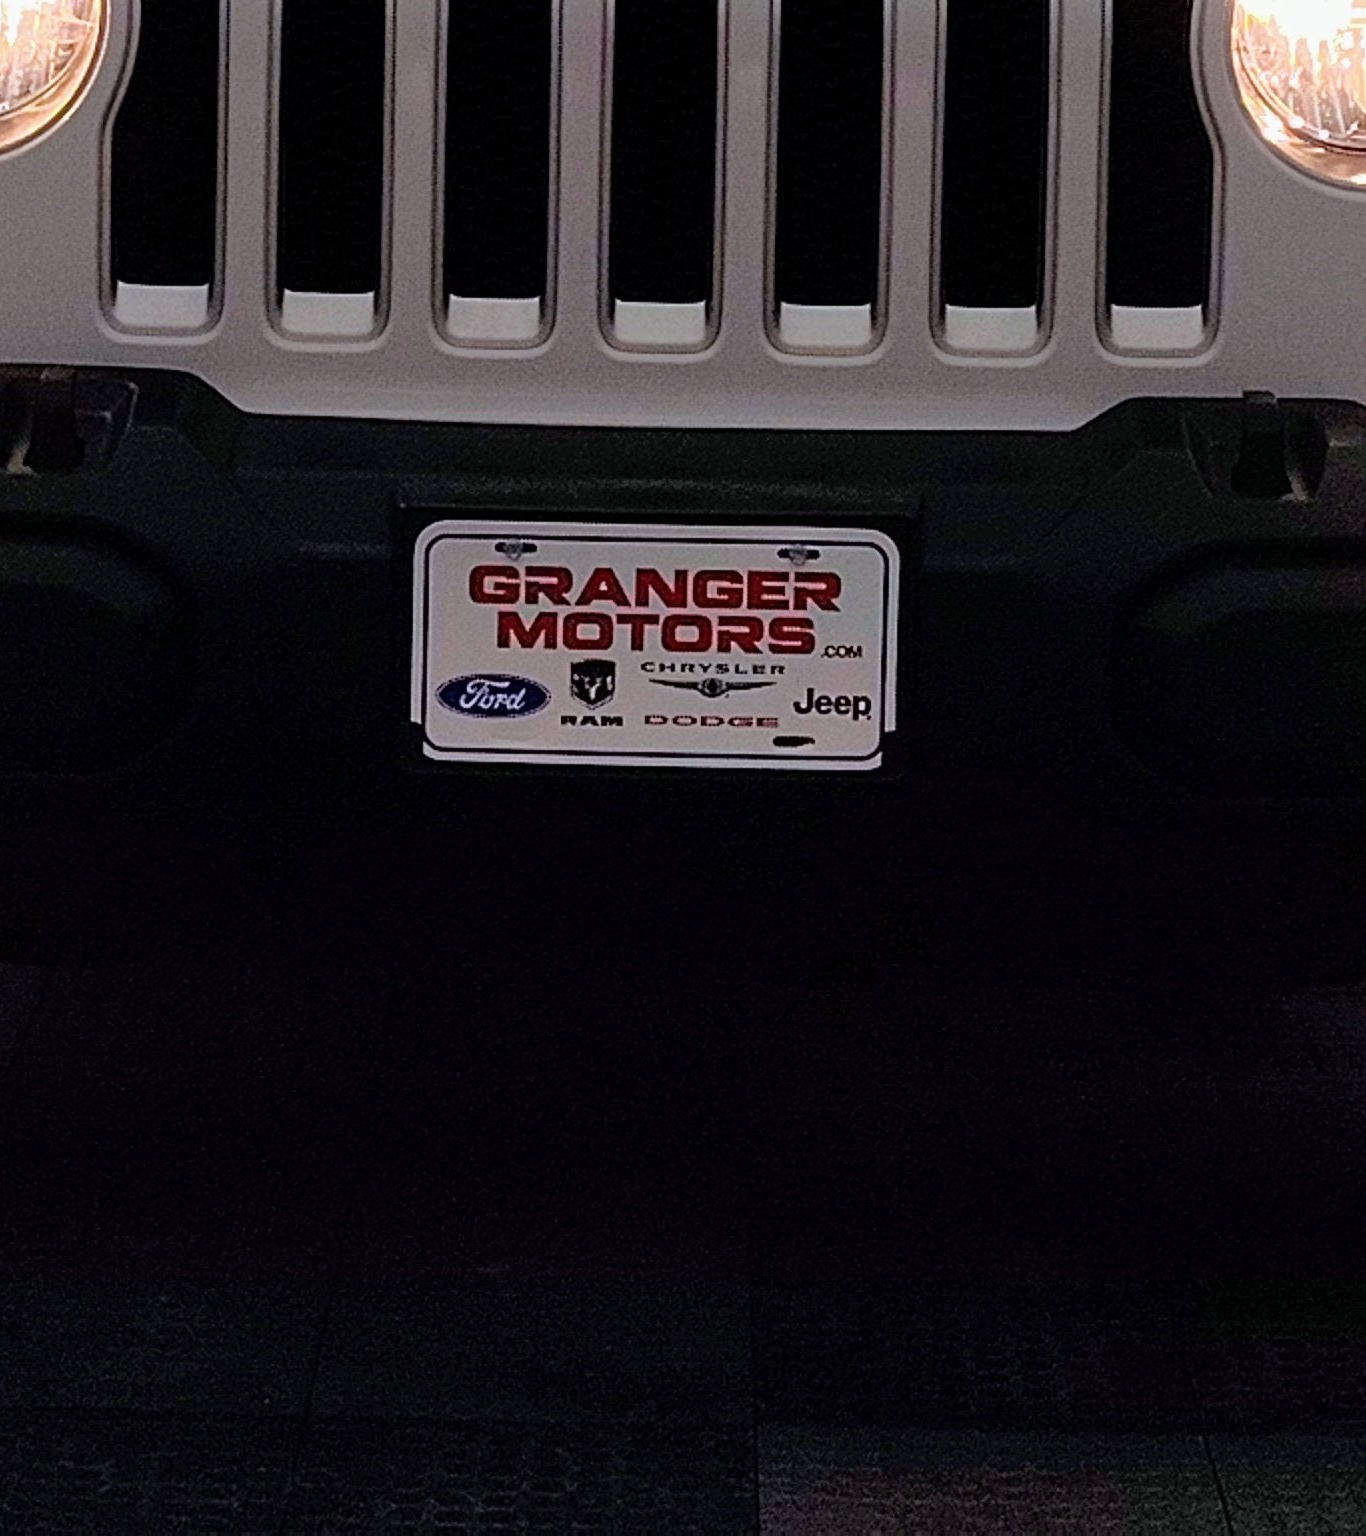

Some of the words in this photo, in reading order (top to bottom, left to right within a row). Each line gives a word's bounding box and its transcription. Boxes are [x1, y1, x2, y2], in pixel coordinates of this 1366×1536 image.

[468, 564, 842, 612] GRANGER
[497, 611, 816, 655] MOTORS
[639, 661, 787, 676] CHRYSLER
[458, 679, 527, 712] Ford
[793, 687, 872, 721] Jeep
[560, 714, 624, 728] RAM
[643, 714, 780, 729] DODGE
